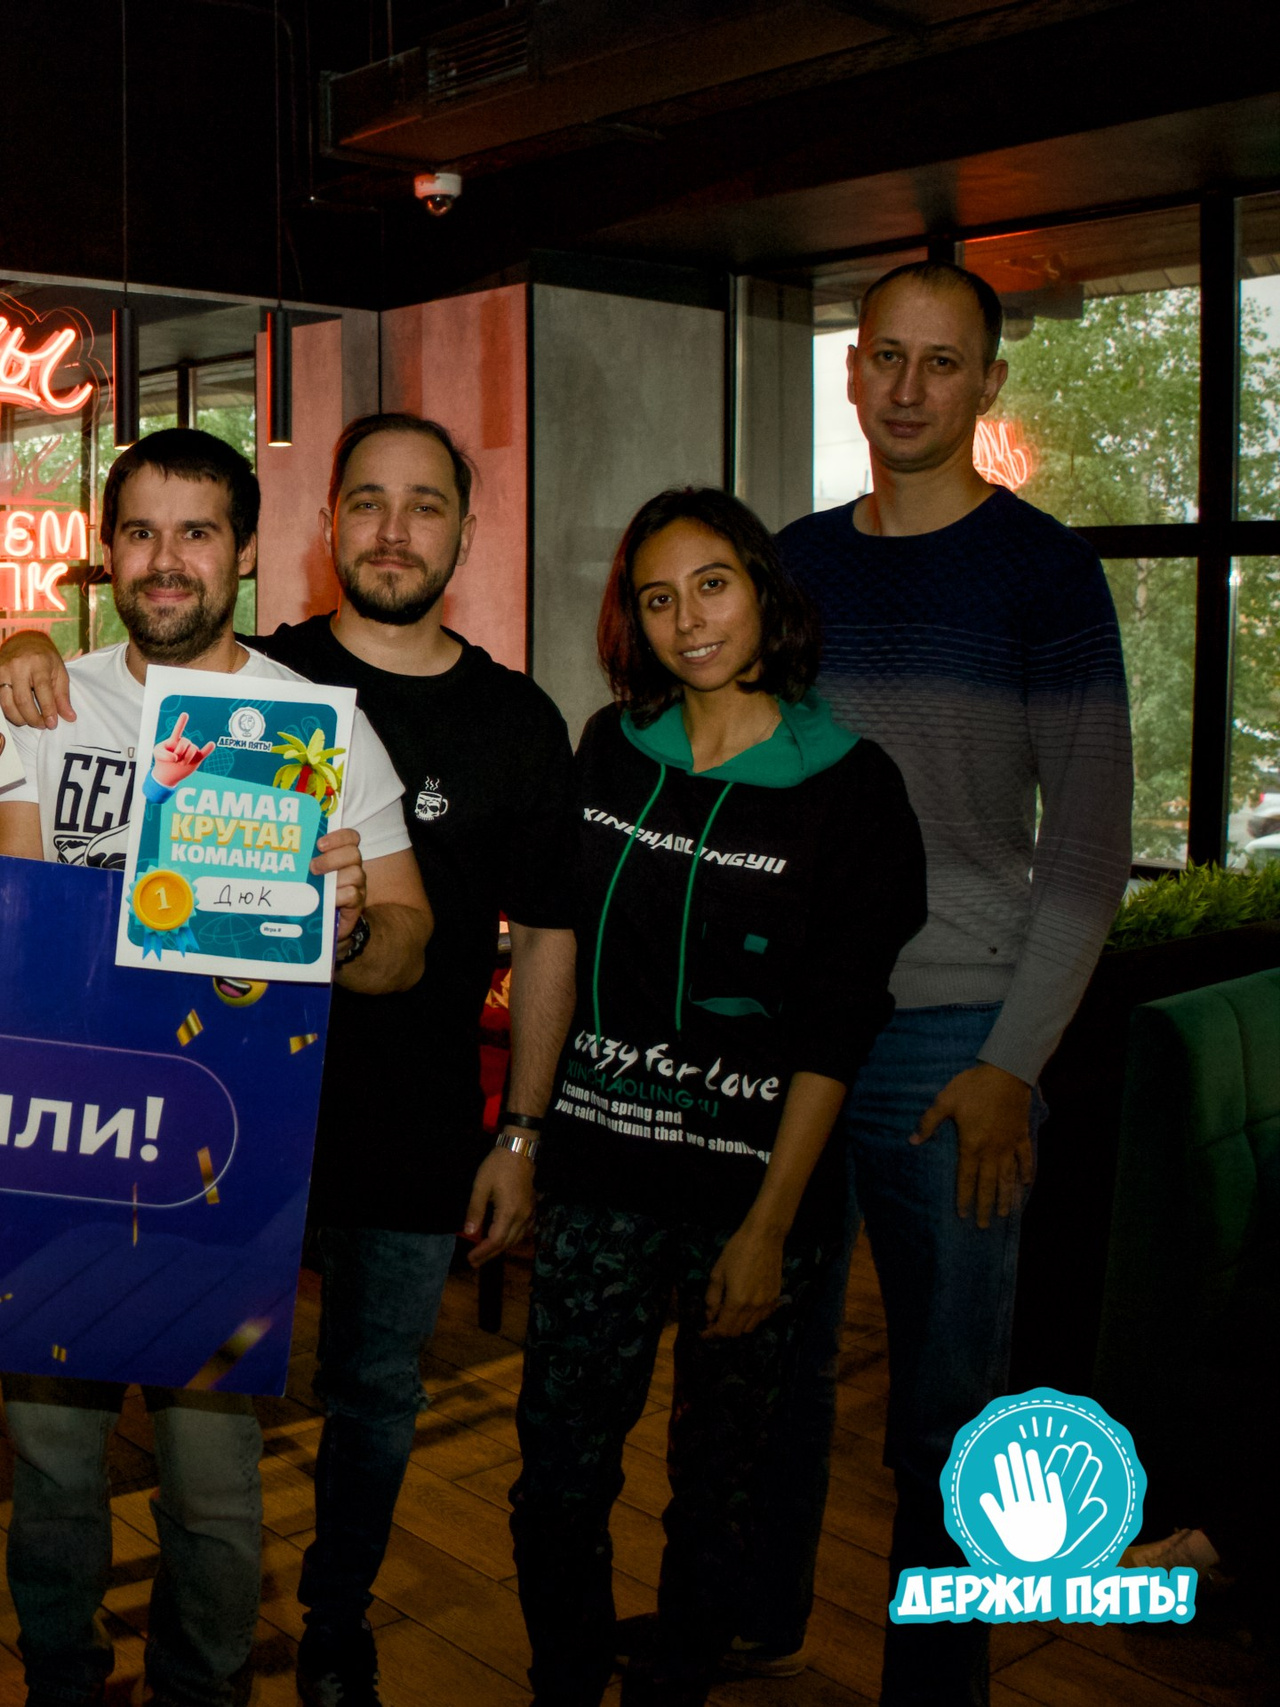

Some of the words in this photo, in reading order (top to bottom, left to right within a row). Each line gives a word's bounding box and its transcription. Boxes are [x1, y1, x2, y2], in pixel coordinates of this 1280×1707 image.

[218, 738, 247, 748] ДЕРЖИ
[248, 741, 272, 751] ПЯТЬ!
[175, 787, 300, 823] САМАЯ
[170, 813, 302, 852] КРУТАЯ
[171, 843, 296, 873] КОМАНДА
[154, 886, 172, 911] 1
[644, 1043, 703, 1083] for
[566, 1058, 721, 1118] XINCHAOLINGU
[567, 1082, 590, 1103] came
[590, 1091, 609, 1111] from
[611, 1100, 653, 1123] spring
[655, 1109, 683, 1125] and
[555, 1098, 574, 1114] you
[574, 1104, 596, 1123] said
[607, 1116, 651, 1139] autumn
[654, 1126, 684, 1143] that
[686, 1132, 705, 1147] we
